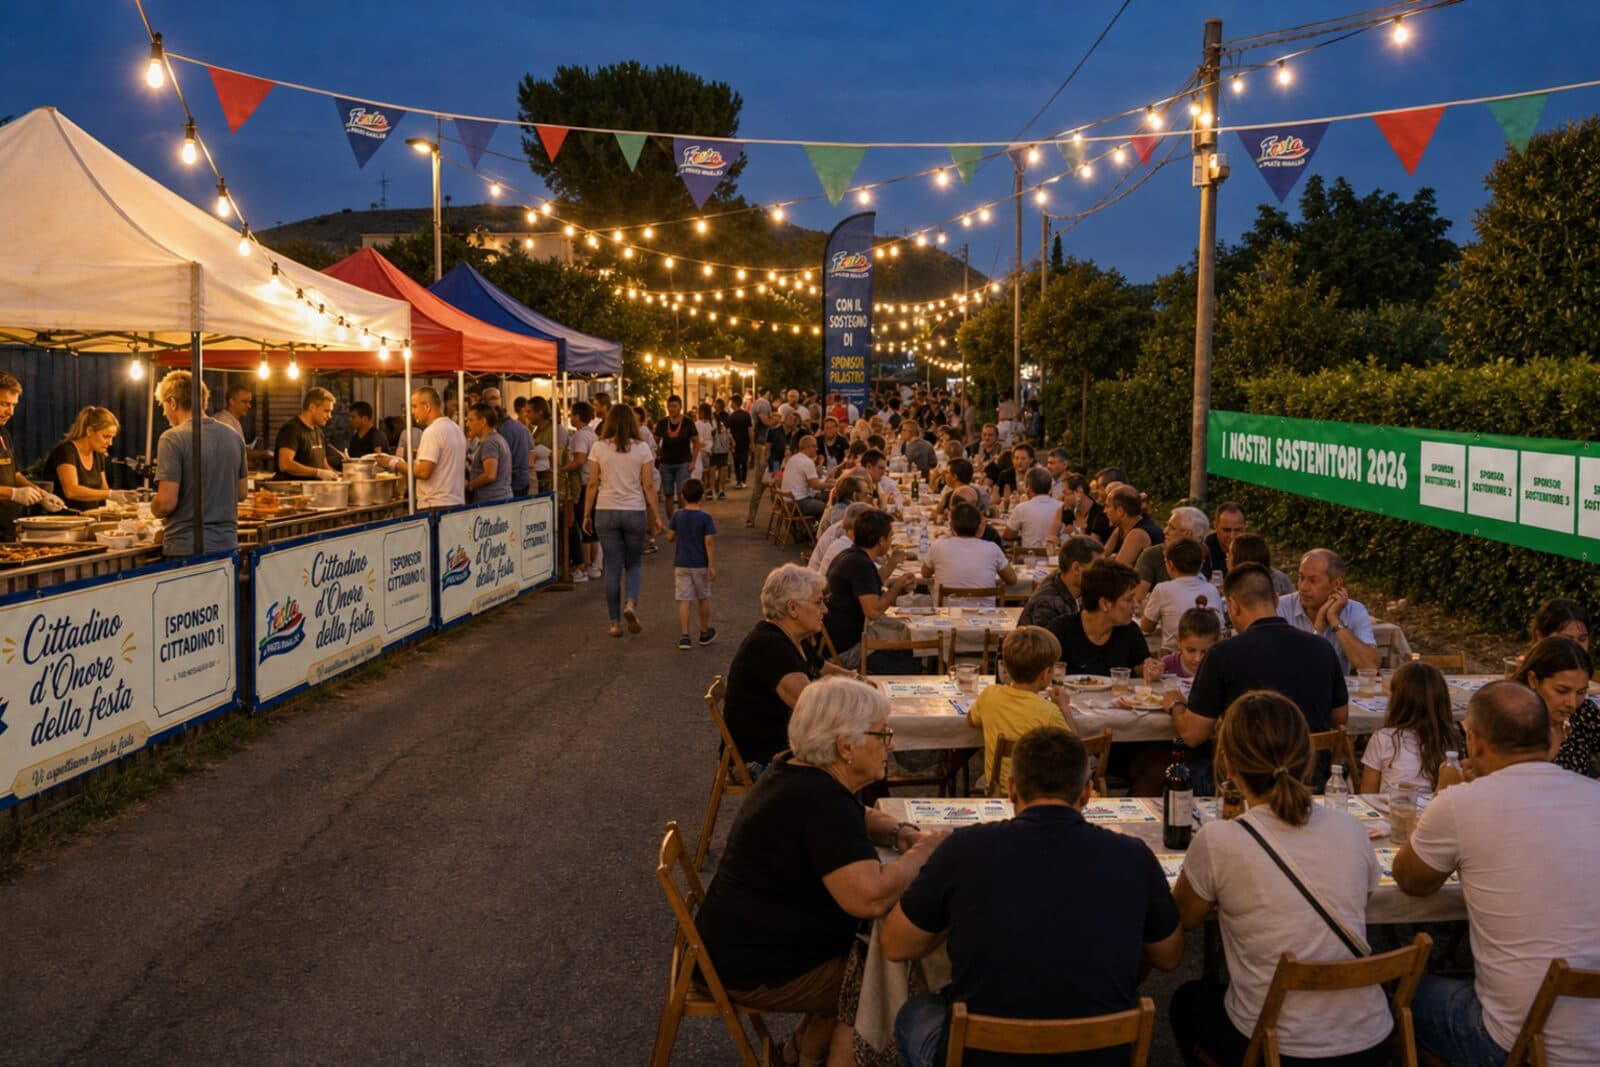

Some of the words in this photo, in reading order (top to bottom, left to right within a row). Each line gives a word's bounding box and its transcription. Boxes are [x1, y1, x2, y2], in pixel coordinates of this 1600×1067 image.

[836, 298, 853, 312] CON
[855, 298, 863, 312] IL
[829, 315, 868, 328] SOSTEGNO
[843, 332, 853, 347] DI
[831, 356, 865, 369] SPONSOR
[830, 371, 865, 384] PILASTRO
[1222, 431, 1226, 459] I
[1230, 432, 1271, 465] NOSTRI
[1275, 438, 1362, 482] SOSTENITORI
[1367, 448, 1407, 490] 2026
[1431, 463, 1454, 474] SPONSOR
[1480, 470, 1504, 481] SPONSOR
[1533, 477, 1561, 489] SPONSOR
[1508, 488, 1512, 497] 2
[311, 550, 368, 588] Cittadino
[315, 581, 364, 618] d'Onore
[165, 603, 219, 638] [SPONSOR
[266, 596, 300, 636] Festa
[316, 615, 347, 649] della
[346, 603, 374, 645] festa
[23, 608, 123, 665] Cittadino
[160, 628, 215, 663] CITTADINO
[216, 624, 224, 645] 1]
[29, 653, 115, 705] d'Onore
[31, 699, 84, 747] della
[83, 678, 134, 737] festa
[32, 768, 45, 786] Vi
